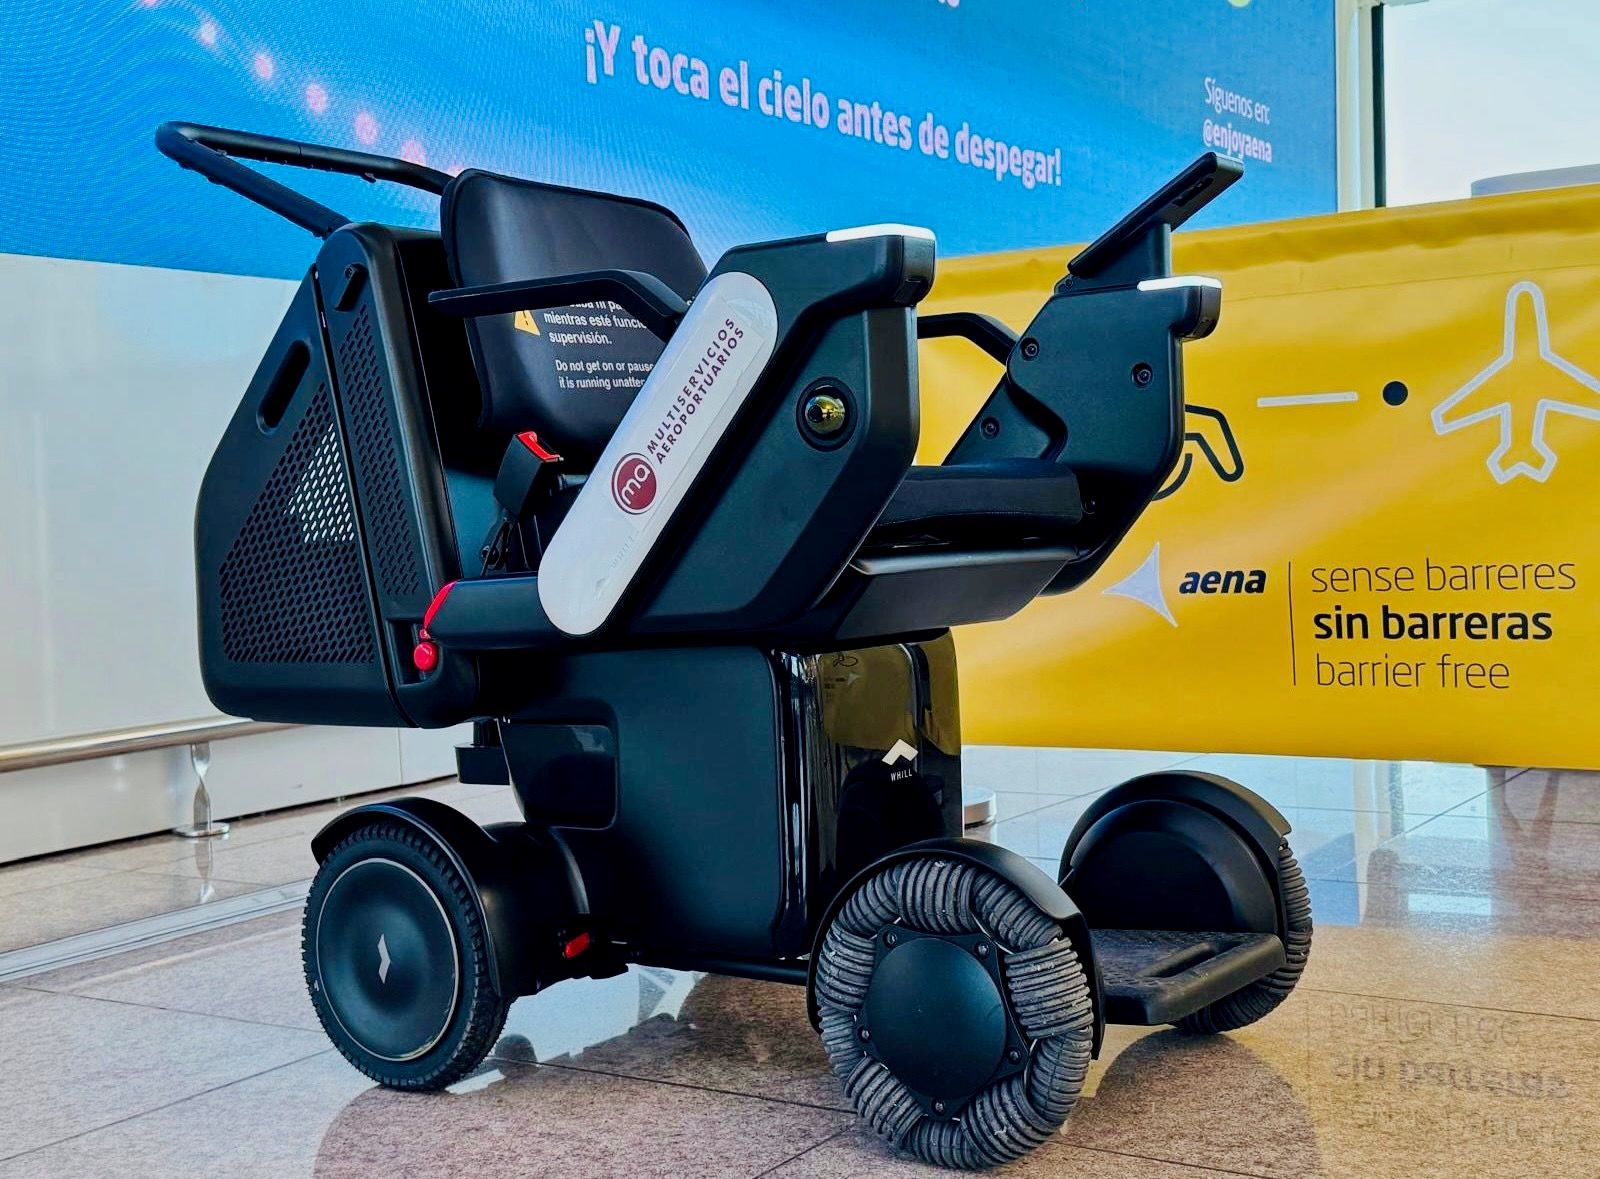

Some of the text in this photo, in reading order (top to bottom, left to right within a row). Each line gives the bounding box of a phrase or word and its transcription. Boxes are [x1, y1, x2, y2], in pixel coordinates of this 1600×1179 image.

[584, 20, 1062, 189] ¡Y toca el cielo antes de despegar!
[1202, 119, 1273, 163] @enjoyaena
[543, 312, 587, 326] mientras
[589, 314, 612, 327] esté
[549, 332, 613, 346] supervisión.
[555, 360, 568, 371] Do
[569, 361, 584, 372] not
[586, 360, 601, 374] get
[602, 362, 614, 371] on
[615, 362, 626, 371] or
[559, 376, 566, 388] it
[567, 377, 575, 388] is
[576, 377, 611, 391] running
[647, 318, 736, 455] MULTISERVICIOS
[655, 327, 744, 465] AEROPORTUARIOS
[1179, 568, 1267, 595] aena
[1311, 557, 1577, 593] sense barreres
[1314, 604, 1554, 641] sin barreras
[1316, 653, 1510, 689] barrier free
[890, 768, 913, 782] WHILL
